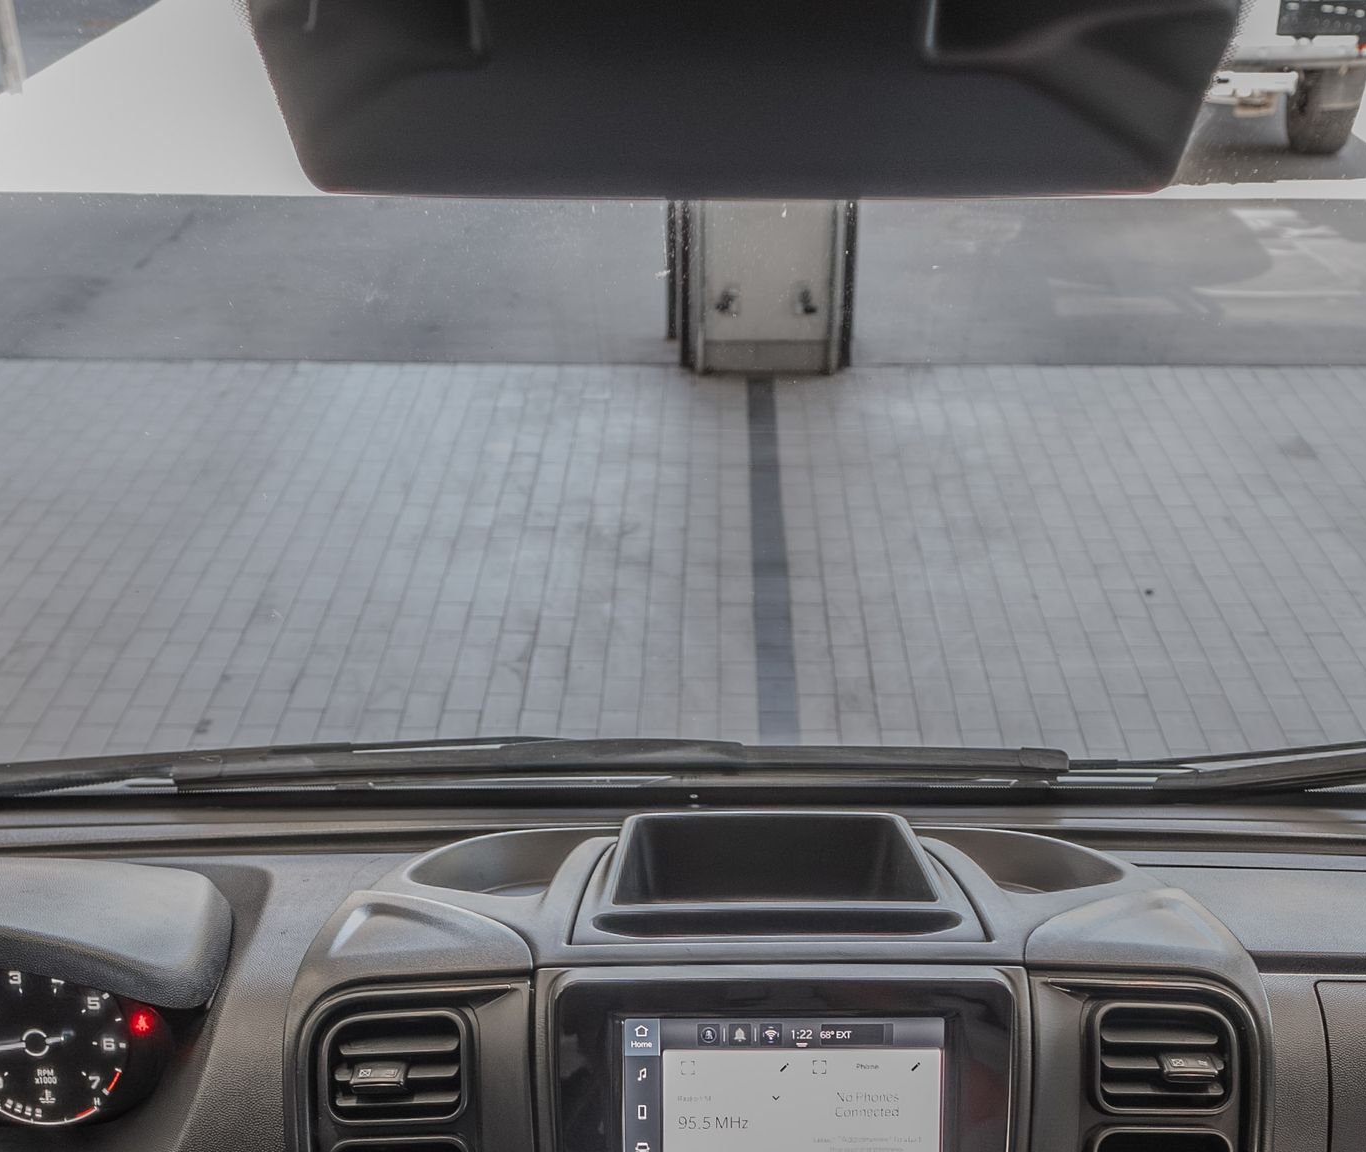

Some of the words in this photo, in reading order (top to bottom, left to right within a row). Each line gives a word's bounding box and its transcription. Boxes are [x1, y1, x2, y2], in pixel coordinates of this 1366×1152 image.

[8, 971, 22, 985] 3
[87, 997, 101, 1010] 5
[791, 1030, 813, 1040] 1:22
[836, 1030, 852, 1040] EXT
[102, 1038, 115, 1051] 6
[631, 1040, 653, 1048] Home
[37, 1068, 54, 1077] RPM
[35, 1077, 57, 1085] x1000
[88, 1076, 101, 1090] 7
[93, 1097, 101, 1106] H
[836, 1092, 853, 1103] No
[856, 1091, 900, 1103] Phones
[835, 1107, 900, 1118] Connected
[678, 1116, 711, 1130] 95.5
[715, 1116, 749, 1130] MHz
